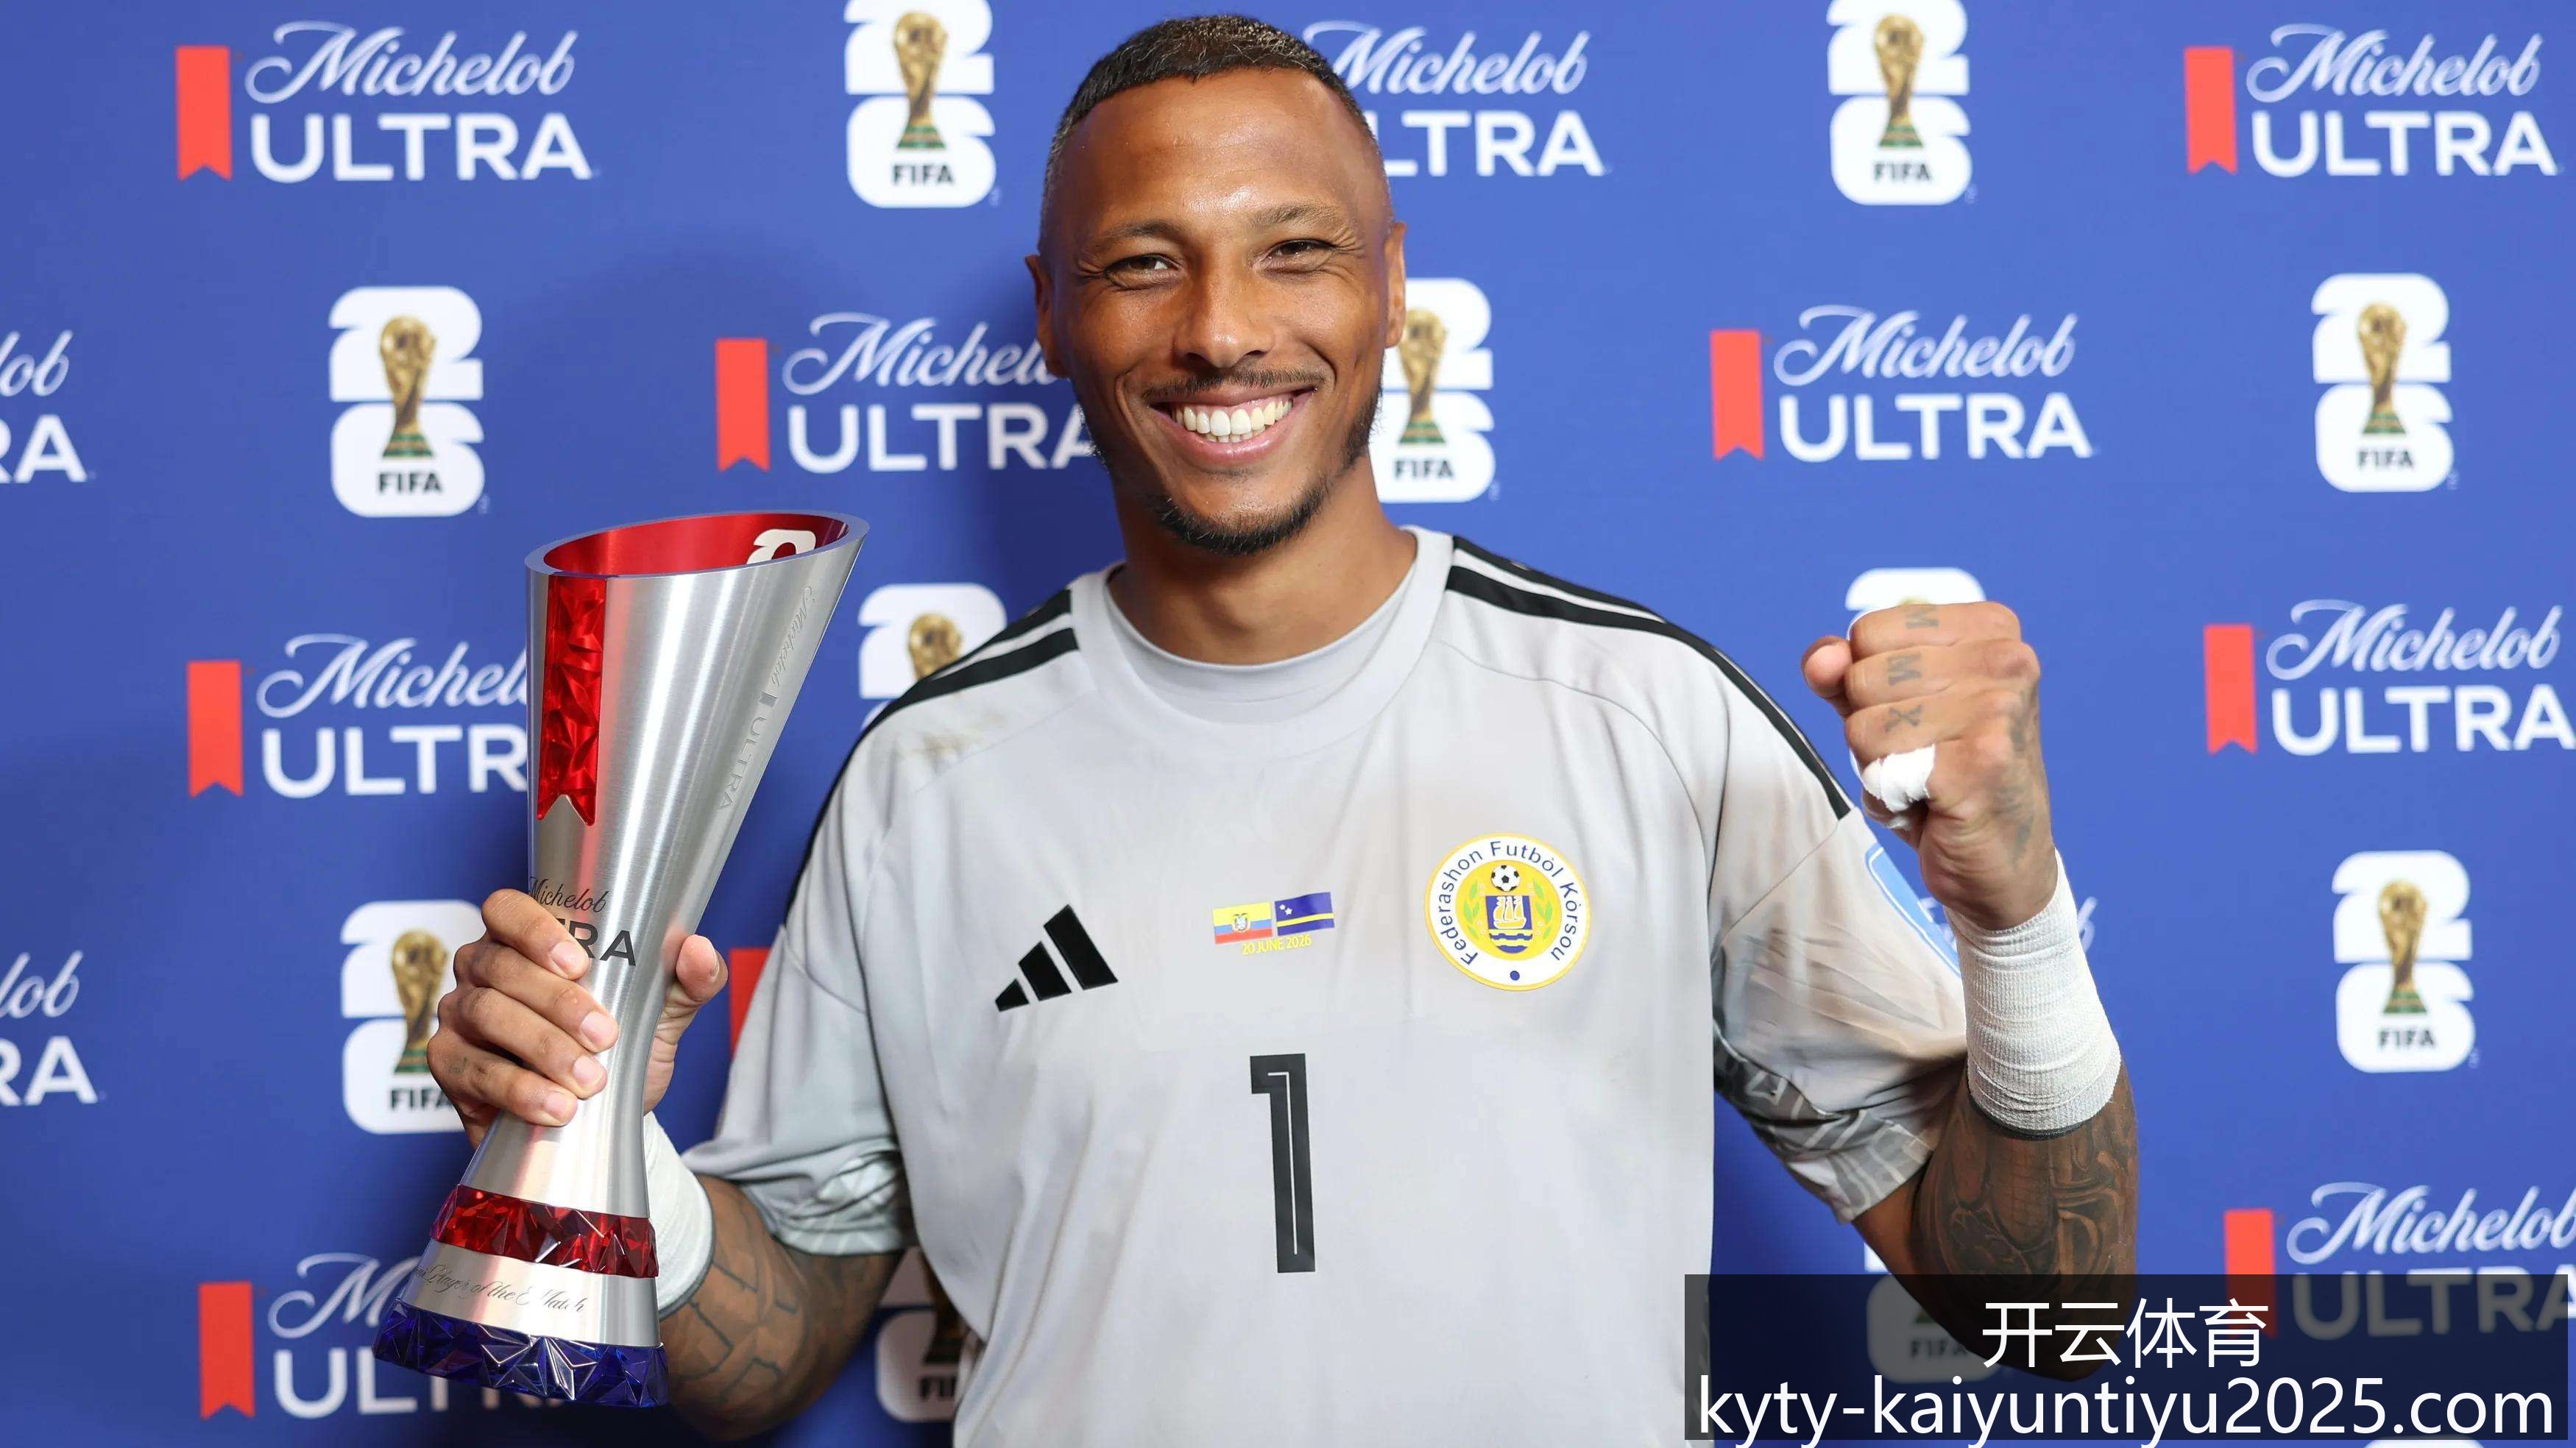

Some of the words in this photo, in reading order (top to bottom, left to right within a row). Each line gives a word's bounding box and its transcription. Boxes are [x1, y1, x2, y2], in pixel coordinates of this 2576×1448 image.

[244, 21, 578, 104] Michelob
[1302, 20, 1592, 95] Michelob
[2246, 23, 2544, 102] Michelob
[250, 113, 592, 183] ULTRA
[892, 163, 955, 185] FIFA
[1873, 161, 1932, 182] FIFA
[2251, 110, 2558, 177] ULTRA
[782, 312, 1060, 395] Michel
[1774, 305, 2078, 386] Michelob
[1779, 392, 2092, 462] ULTRA
[2357, 447, 2415, 471] FIFA
[378, 470, 444, 494] FIFA
[1393, 457, 1454, 479] FIFA
[771, 586, 815, 686] Michelob
[2266, 599, 2563, 681] Michelob
[256, 633, 527, 718] Michel
[2271, 684, 2576, 756] ULTRA
[261, 723, 528, 798] ULTR
[721, 717, 767, 808] ULTRA
[1242, 942, 1255, 955] 20
[1256, 938, 1284, 954] JUNE
[1286, 934, 1312, 950] 2026
[1438, 850, 1484, 965] Federashon
[2377, 1027, 2435, 1050] FIFA
[1250, 1053, 1315, 1274] 1
[2286, 1182, 2576, 1265] Michelob
